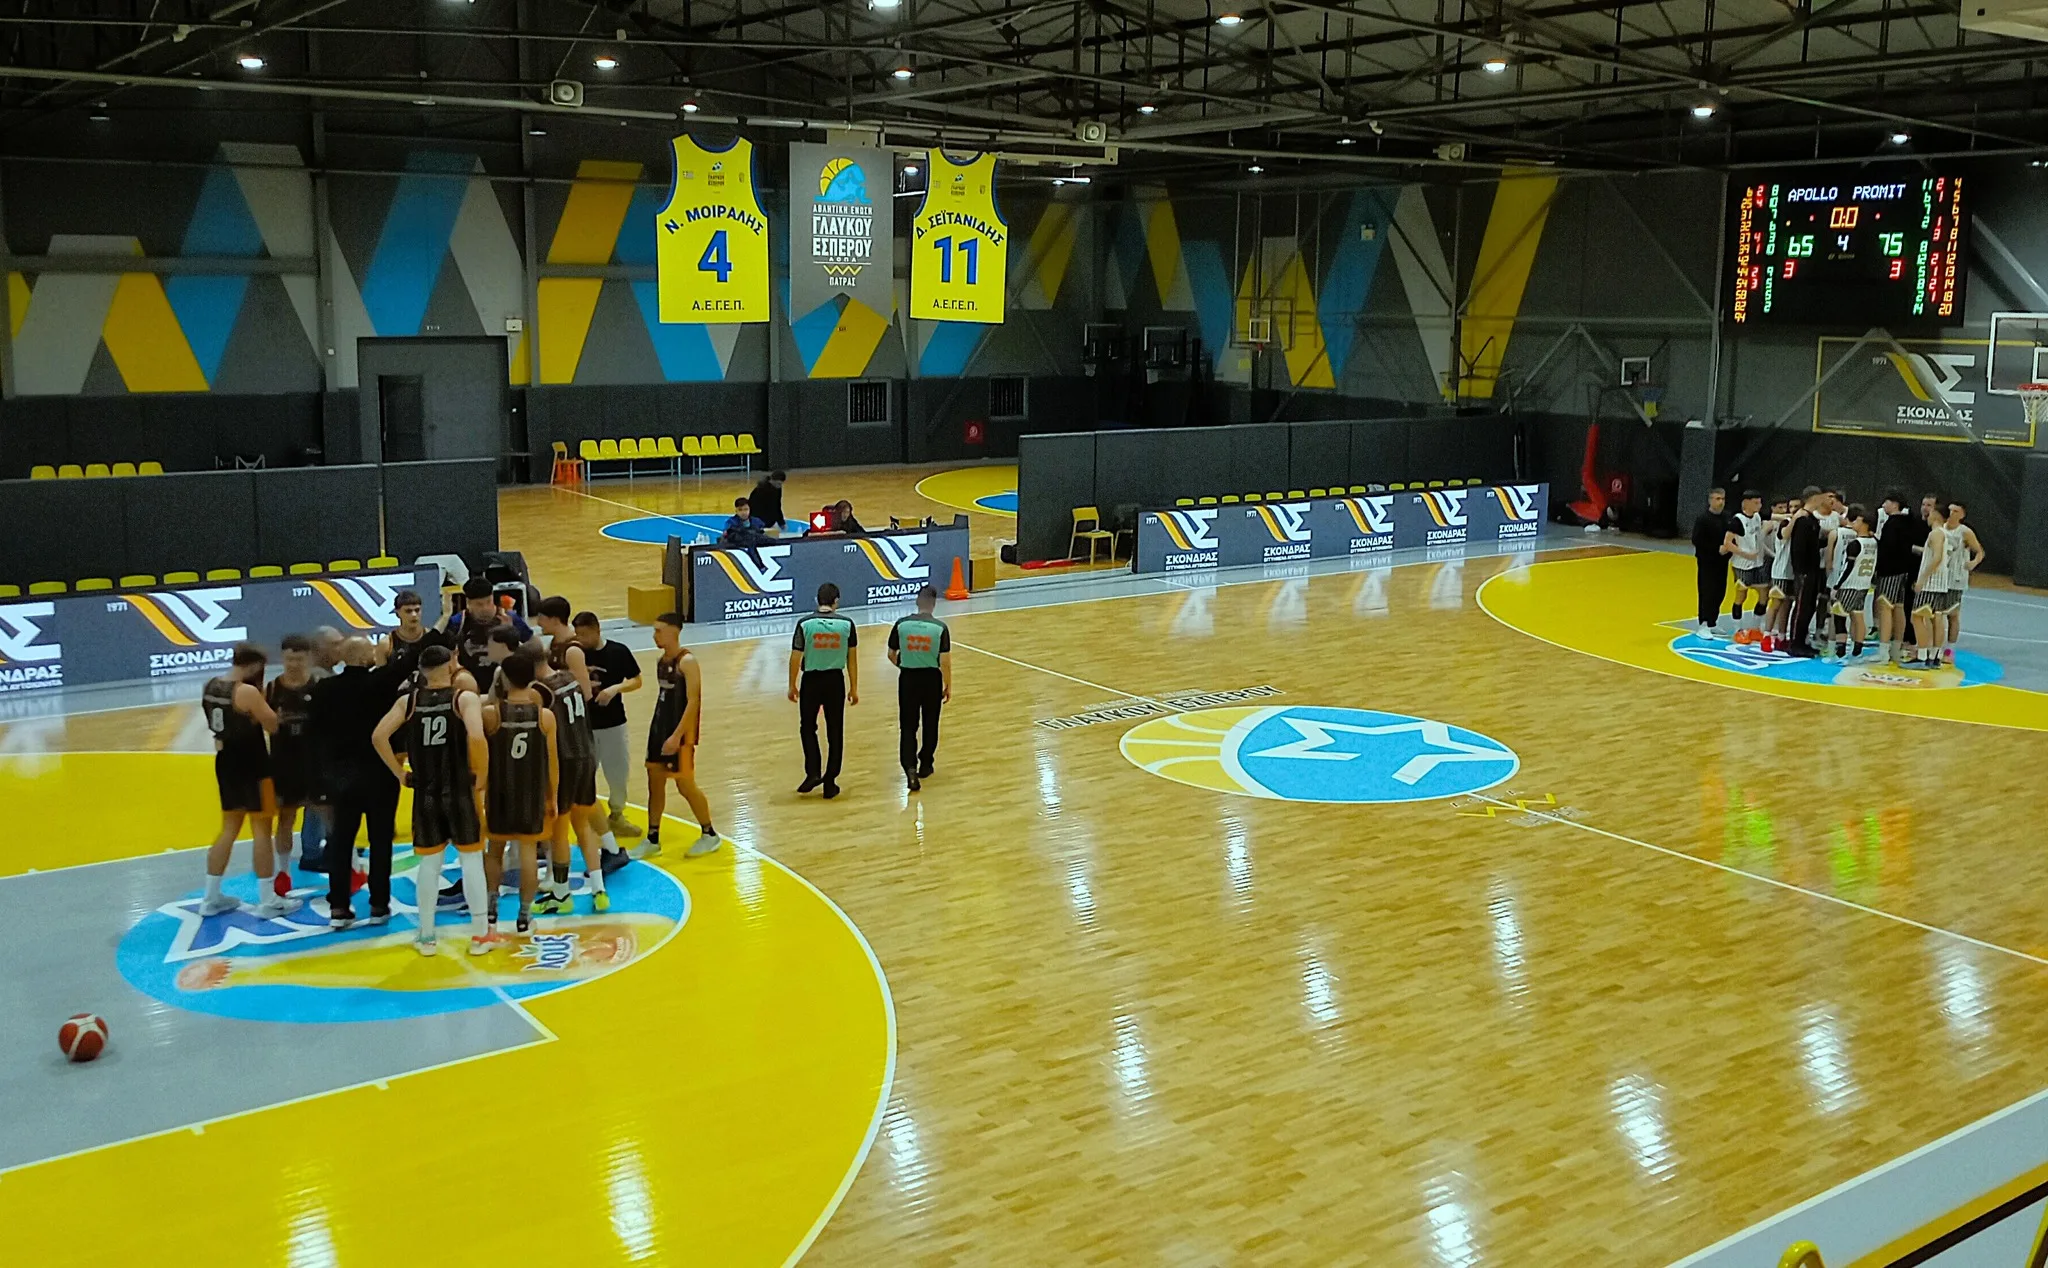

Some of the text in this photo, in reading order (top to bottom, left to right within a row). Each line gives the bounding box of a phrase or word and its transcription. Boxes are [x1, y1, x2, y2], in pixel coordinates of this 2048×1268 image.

[1788, 184, 1906, 202] APOLLO PROMIT
[664, 205, 764, 236] Ν. ΜΟΙΡΑΛΗΣ
[813, 216, 873, 236] ΓΛΑΥΚΟΥ
[915, 210, 1005, 247] Δ. ΣΕΪΤΑΝΙΔΗΣ
[813, 237, 873, 257] ΕΣΠΕΡΟΥ
[1787, 232, 1904, 257] 65 4 75
[698, 230, 733, 283] 4
[934, 235, 979, 285] 11
[1783, 261, 1795, 279] 3
[1889, 260, 1902, 279] 3
[829, 277, 856, 287] ΠΑΤΡΑΣ
[692, 300, 745, 311] Α.Ε.Γ.Ε.Π.
[932, 299, 978, 311] Α.Ε.Γ.Ε.Π.
[1145, 517, 1158, 525] 1971
[1499, 522, 1538, 534] ΣΚΟΝΔΡΑΣ
[1350, 535, 1394, 549] ΣΚΟΝΔΡΑΣ
[1427, 528, 1467, 540] ΣΚΟΝΔΡΑΣ
[843, 544, 857, 553] 1971
[1263, 544, 1311, 557] ΣΚΟΝΔΡΑΣ
[697, 556, 712, 566] 1971
[1165, 552, 1218, 565] ΣΚΟΝΔΡΑΣ
[292, 587, 312, 597] 1971
[106, 602, 128, 612] 1971
[724, 595, 793, 613] ΣΚΟΝΔΡΑΣ
[150, 648, 235, 668] ΣΚΟΝΔΡΑ
[563, 691, 585, 724] 14
[1035, 702, 1168, 731] ΓΛΑΥΚΟΥ
[1163, 685, 1286, 710] ΕΣΠΕΡΟΥ
[421, 715, 447, 746] 12
[511, 732, 528, 759] 6
